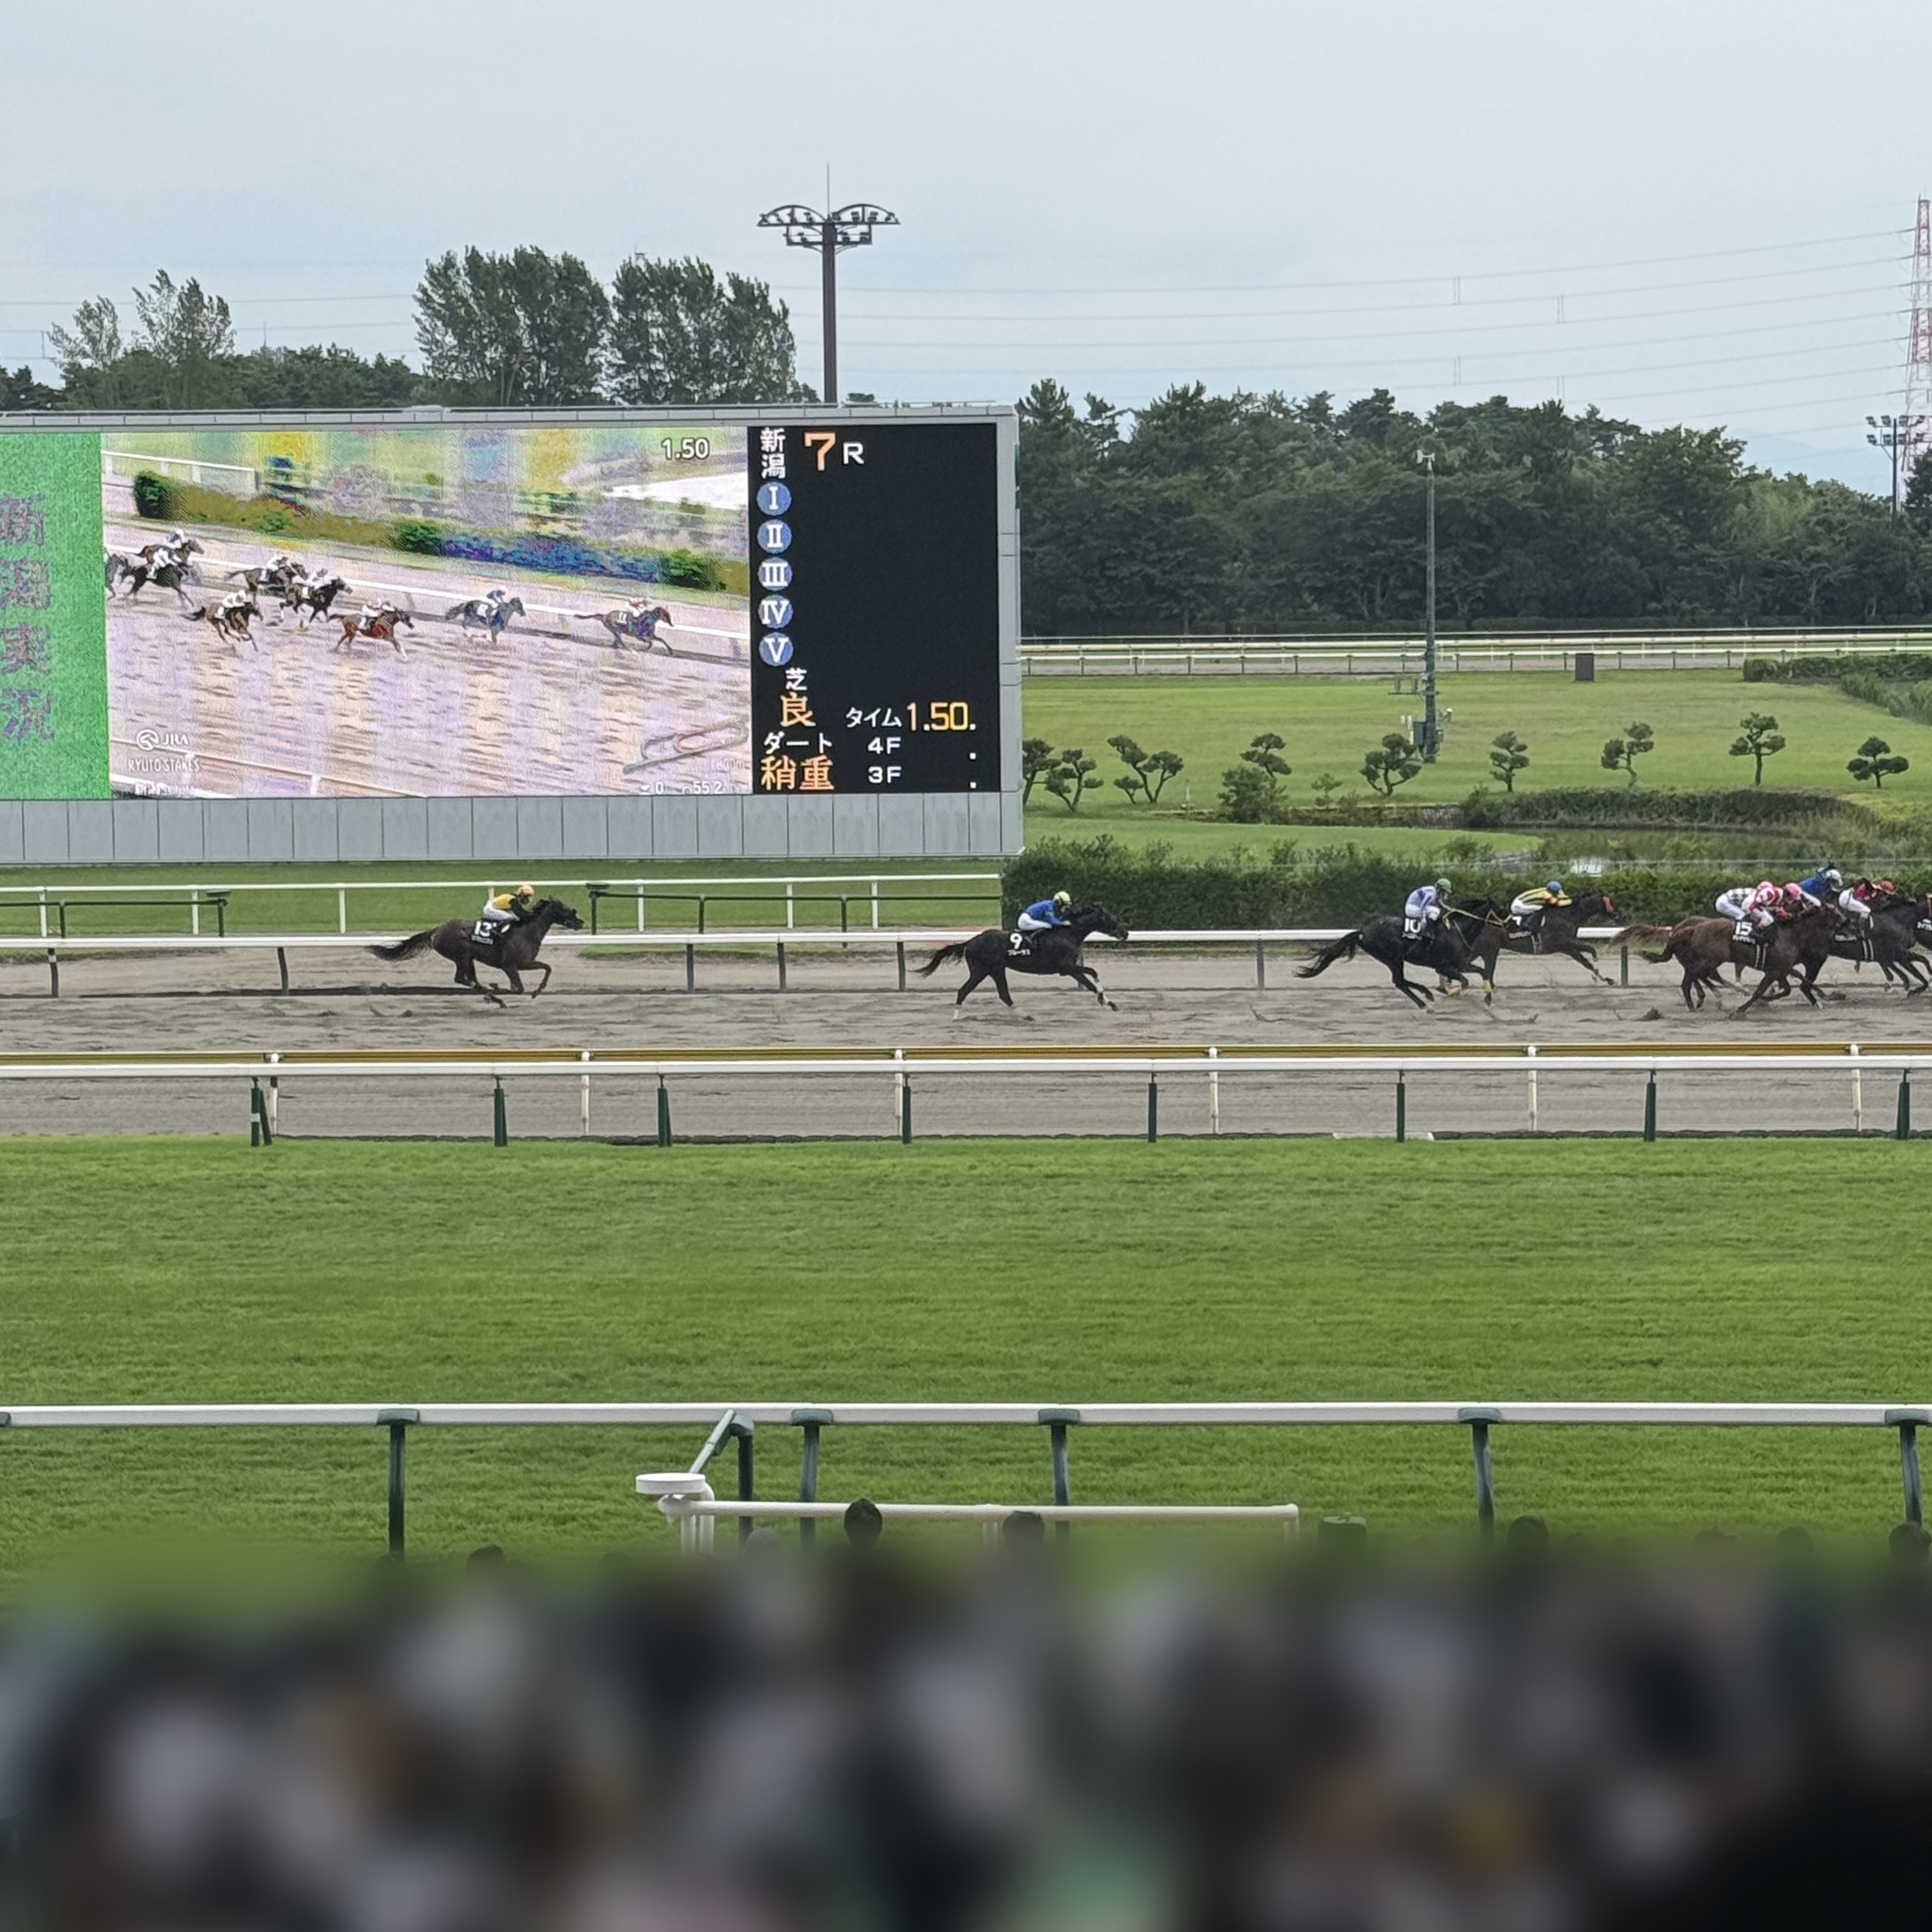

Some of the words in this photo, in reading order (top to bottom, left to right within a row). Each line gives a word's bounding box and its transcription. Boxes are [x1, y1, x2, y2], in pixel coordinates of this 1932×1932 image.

[661, 438, 708, 460] 1.50
[760, 427, 786, 479] 新潟
[785, 667, 808, 691] 芝
[780, 692, 816, 727] 良
[846, 707, 902, 728] タイム
[764, 730, 833, 754] ダート
[867, 736, 902, 755] 4F
[761, 754, 835, 791] 稍重
[868, 766, 902, 784] 3F
[1404, 918, 1421, 933] 10
[1735, 921, 1752, 936] 15
[1010, 933, 1023, 950] 9
